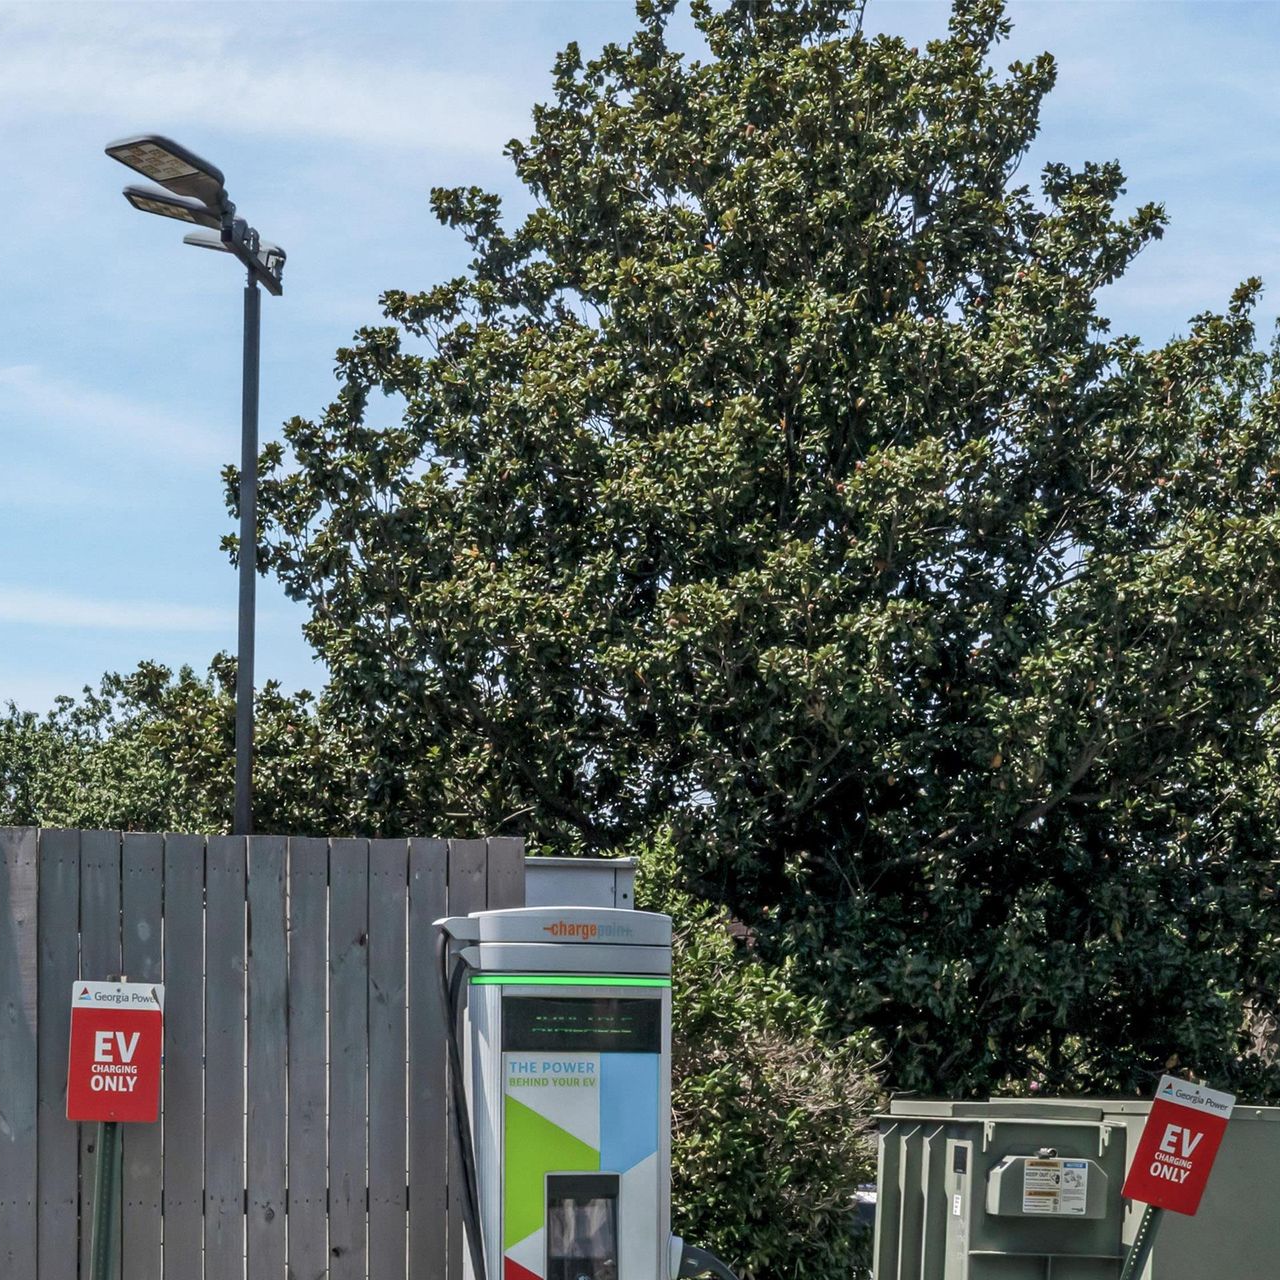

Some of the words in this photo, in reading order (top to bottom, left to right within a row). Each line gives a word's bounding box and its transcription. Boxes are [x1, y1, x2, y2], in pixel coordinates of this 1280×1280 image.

[94, 991, 130, 1004] Georgia
[94, 1031, 141, 1063] EV
[91, 1064, 138, 1074] CHARGING
[509, 1062, 537, 1073] THE
[542, 1062, 595, 1073] POWER
[90, 1075, 138, 1092] ONLY
[509, 1077, 549, 1087] BEHIND
[552, 1077, 579, 1087] YOUR
[583, 1077, 596, 1087] EV
[1175, 1089, 1204, 1104] Georgia
[1205, 1098, 1228, 1111] Power
[1159, 1123, 1204, 1158] EV
[1154, 1151, 1192, 1169] CHARGING
[1150, 1162, 1190, 1184] ONLY
